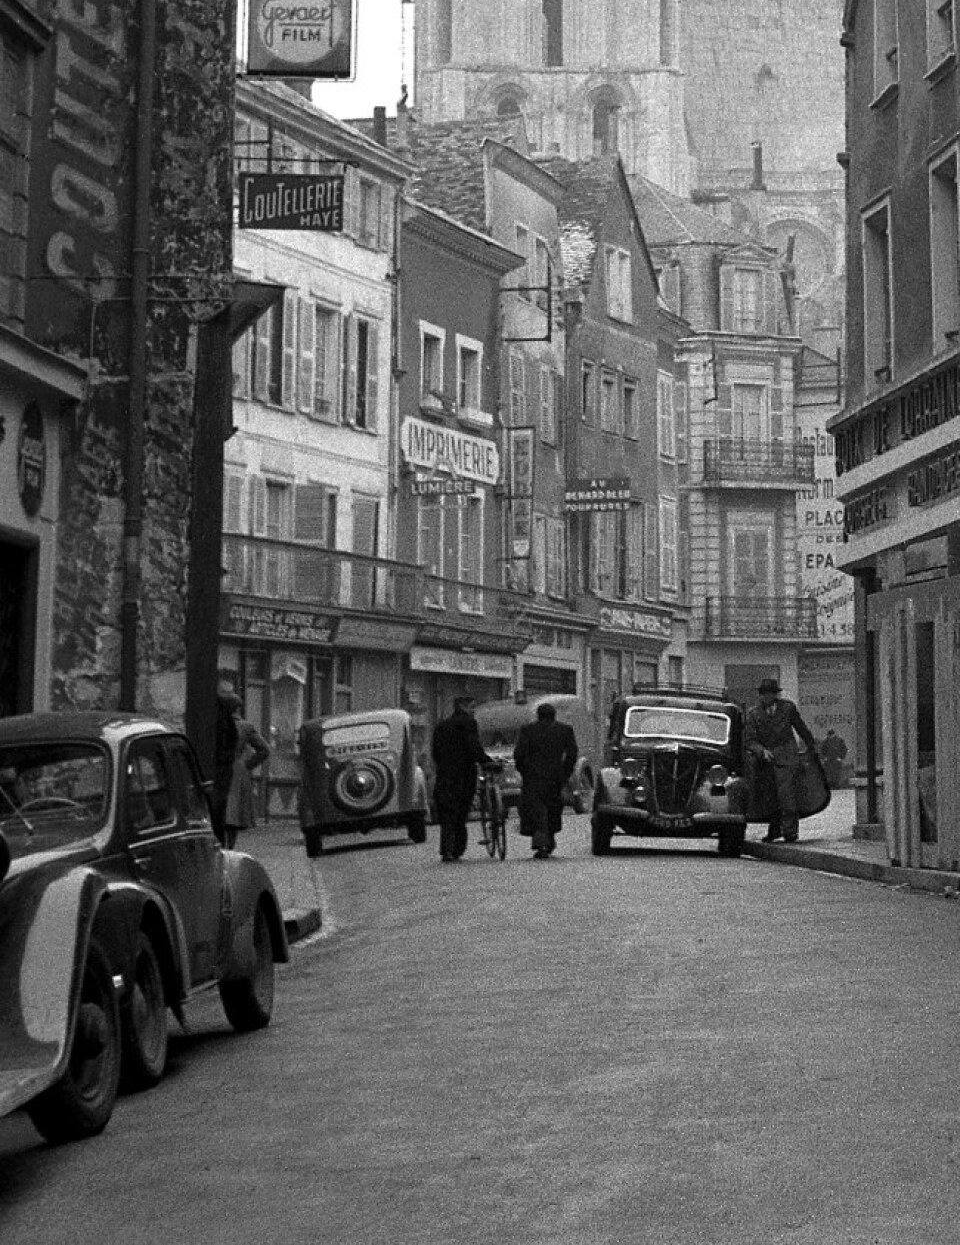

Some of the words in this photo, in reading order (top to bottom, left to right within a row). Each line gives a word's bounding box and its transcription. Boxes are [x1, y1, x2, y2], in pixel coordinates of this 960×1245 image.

[281, 28, 321, 42] FILM
[243, 176, 341, 224] COUTELLERIE
[300, 212, 340, 228] HAYE
[408, 421, 494, 478] IMPRIMERIE
[805, 510, 844, 527] PLAC
[805, 553, 834, 569] EPA
